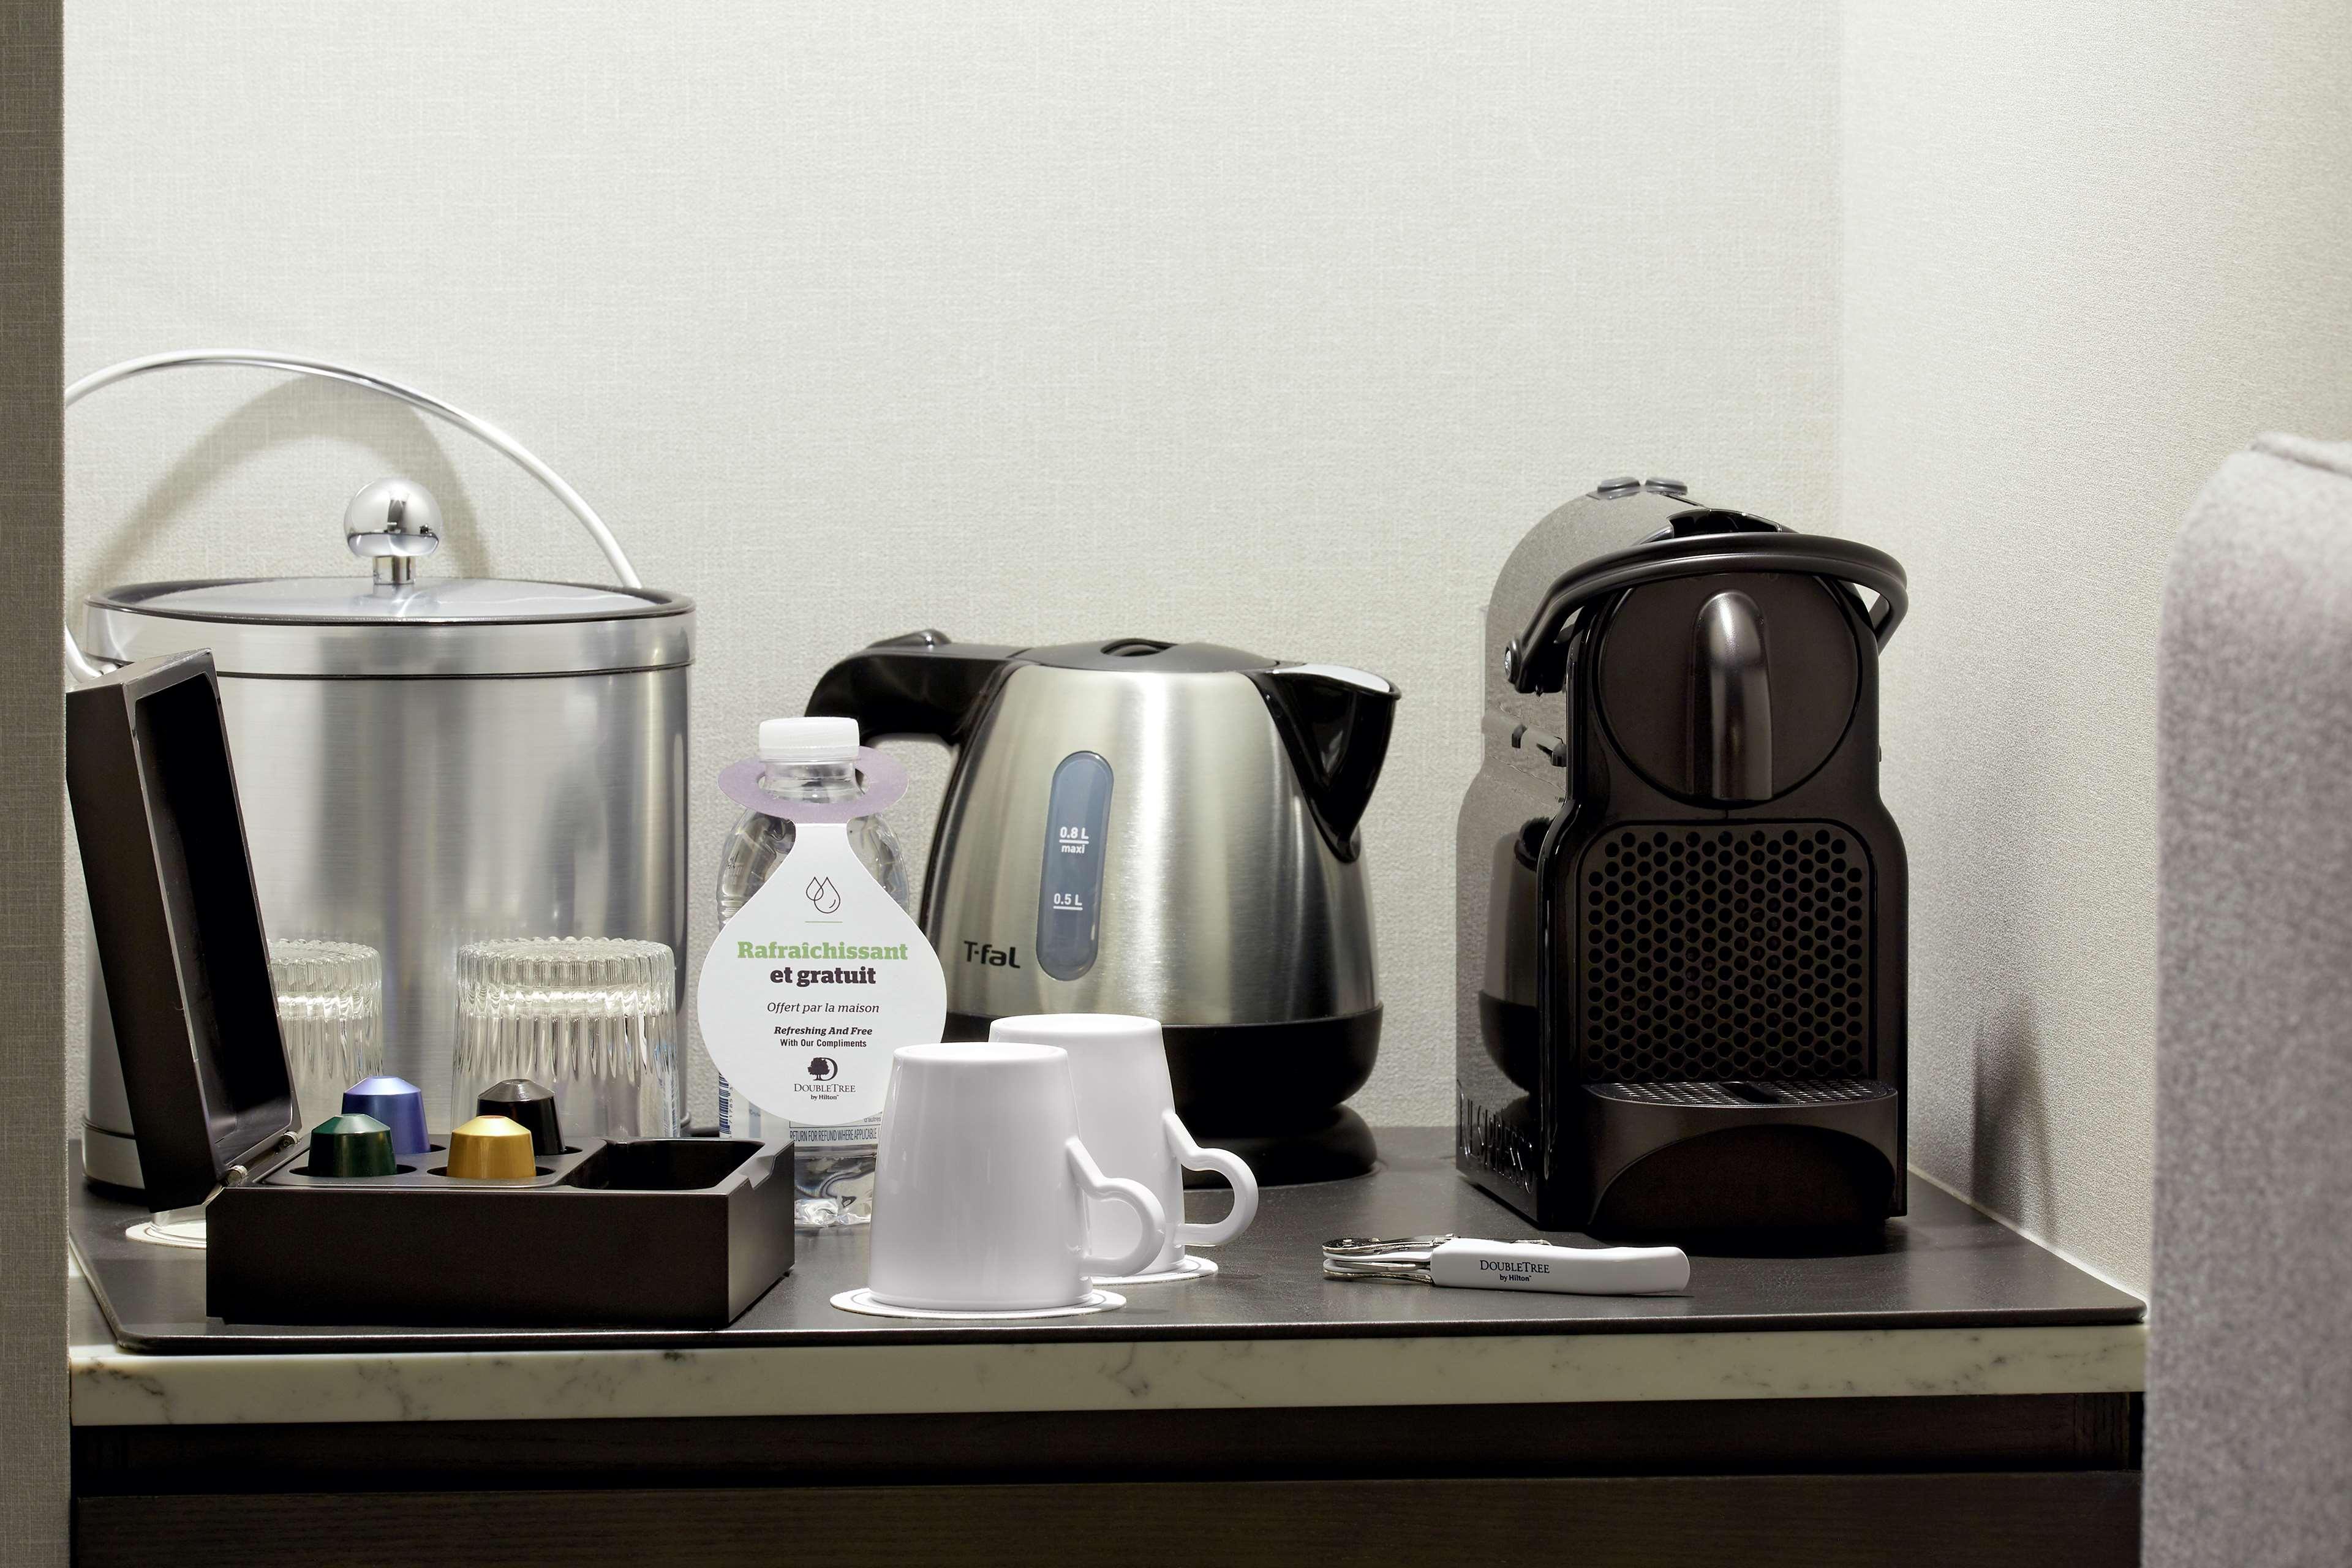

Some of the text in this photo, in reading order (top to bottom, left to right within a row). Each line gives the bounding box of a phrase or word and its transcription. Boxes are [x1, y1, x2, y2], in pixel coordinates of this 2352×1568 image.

[1060, 826, 1089, 839] 0.8 L
[1061, 844, 1085, 854] maxi
[1054, 893, 1082, 906] 0.5 L
[737, 941, 908, 960] Rafraîchissant
[963, 941, 1021, 968] T-fal
[770, 966, 876, 987] et gratuit
[767, 1002, 880, 1014] Offert par la maison
[774, 1026, 873, 1036] Refreshing And Free
[780, 1038, 798, 1047] With
[816, 1039, 867, 1049] Compliments
[790, 1128, 877, 1142] RETURN FOR REFUND WHERE APPLICABLE
